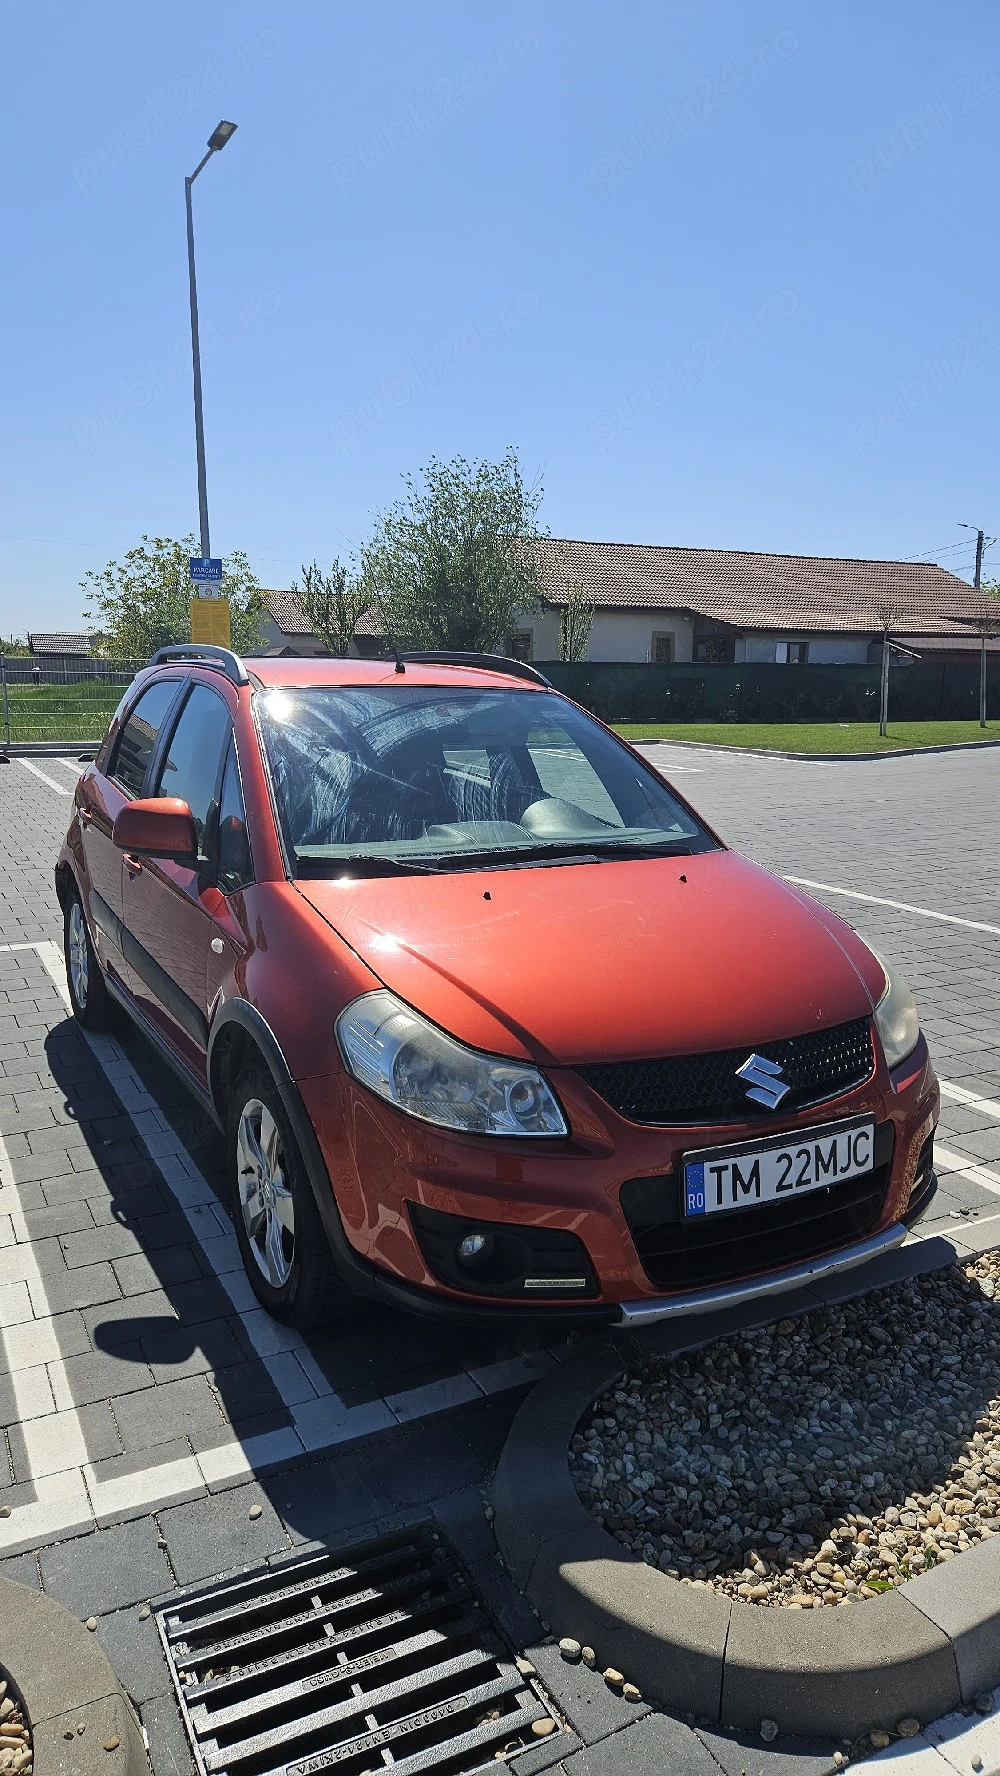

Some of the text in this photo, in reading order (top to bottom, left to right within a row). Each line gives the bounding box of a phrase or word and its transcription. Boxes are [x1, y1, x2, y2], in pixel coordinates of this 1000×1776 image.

[709, 1130, 870, 1205] TM 22MJC
[688, 1192, 704, 1210] RO
